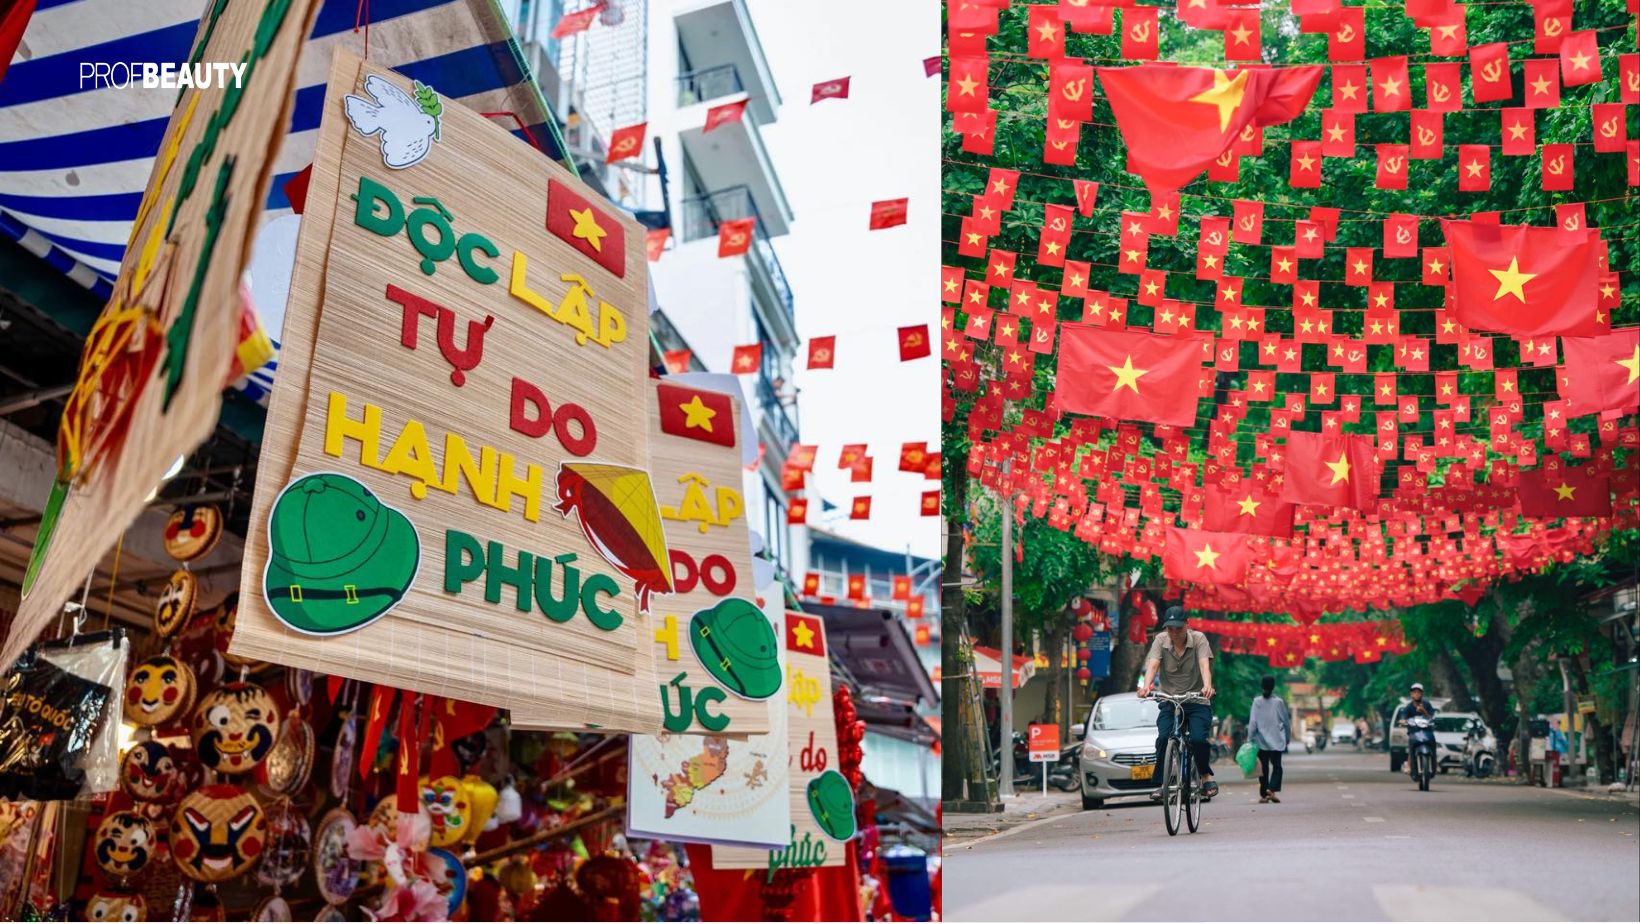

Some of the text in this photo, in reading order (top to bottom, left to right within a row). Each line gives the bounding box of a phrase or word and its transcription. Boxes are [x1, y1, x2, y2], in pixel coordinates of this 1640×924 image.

[351, 176, 627, 349] ĐỘC LẬP
[386, 283, 597, 457] TỰ DO
[324, 392, 624, 631] HẠNH PHÚC
[668, 549, 737, 597] DO
[660, 671, 731, 733] ÚC
[1031, 727, 1042, 739] P
[800, 731, 827, 772] do
